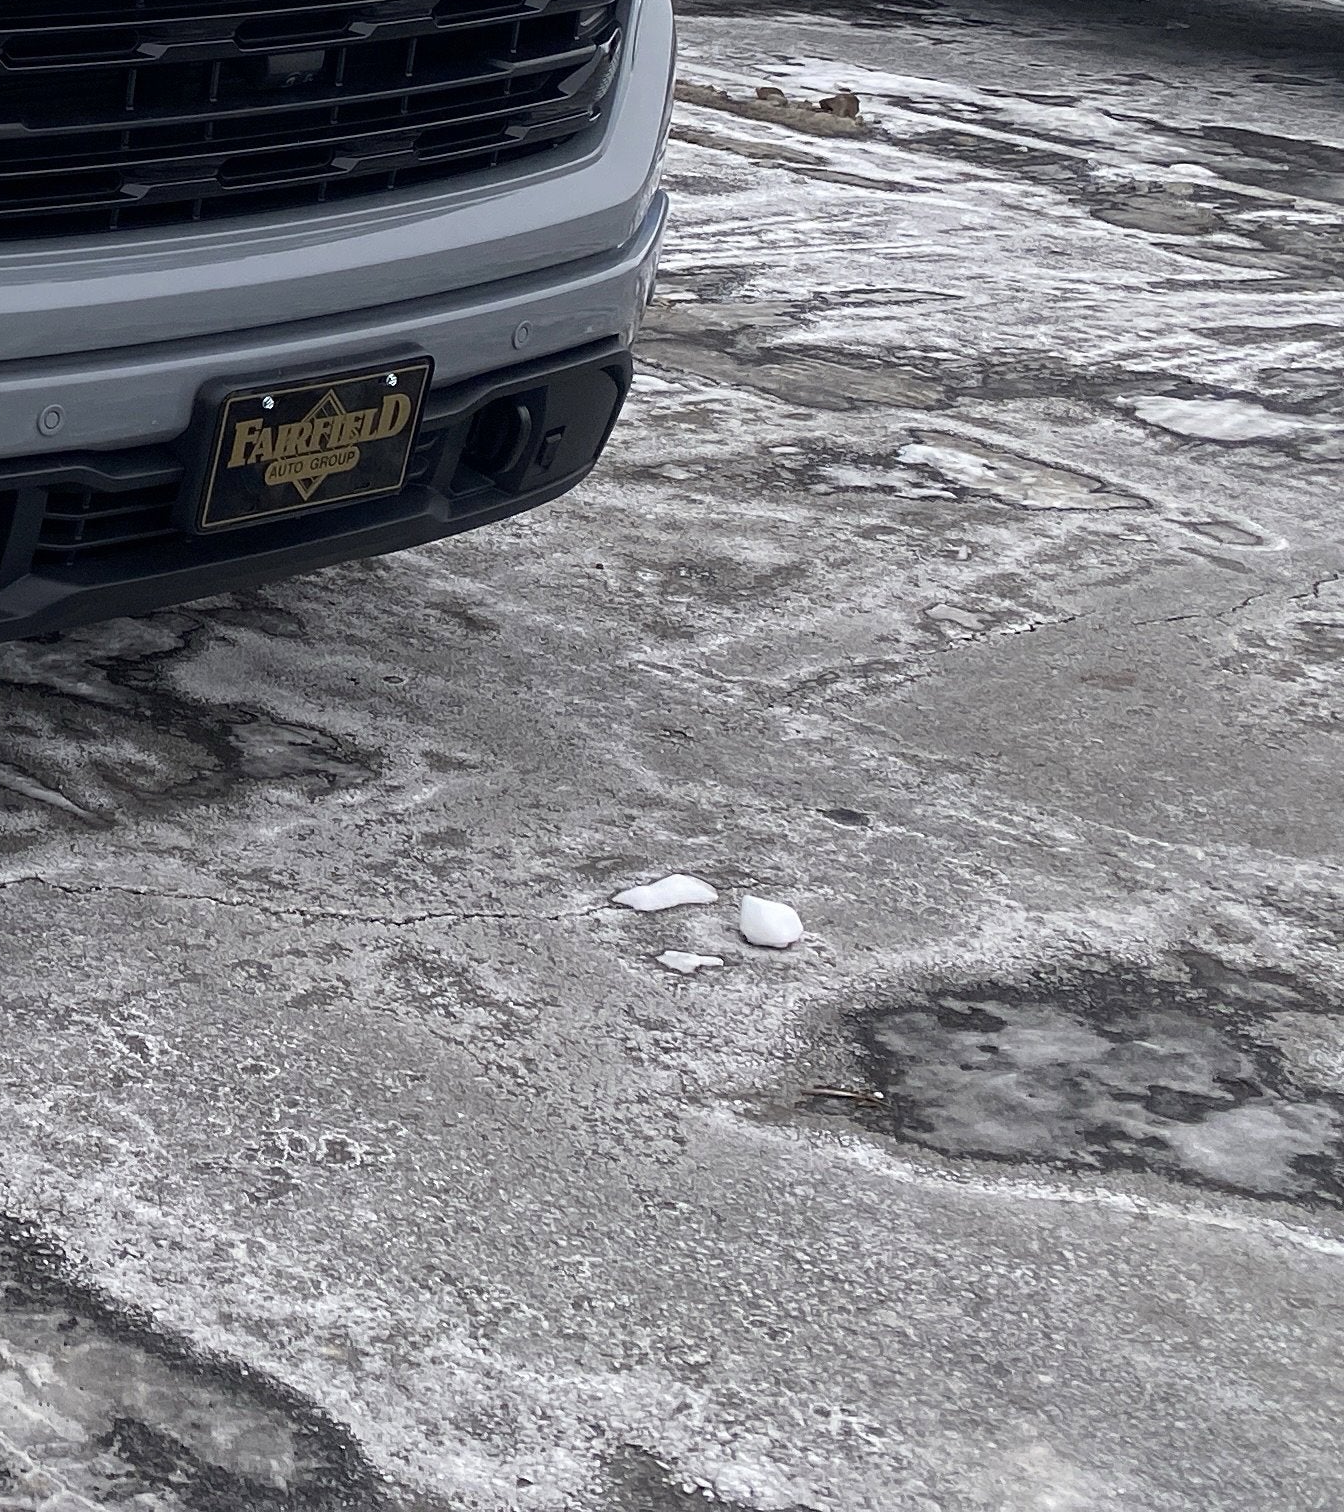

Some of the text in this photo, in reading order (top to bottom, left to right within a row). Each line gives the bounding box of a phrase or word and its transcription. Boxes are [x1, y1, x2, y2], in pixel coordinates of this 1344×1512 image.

[226, 393, 412, 468] FAIRFIELD
[268, 451, 355, 479] AUTO GROUP
